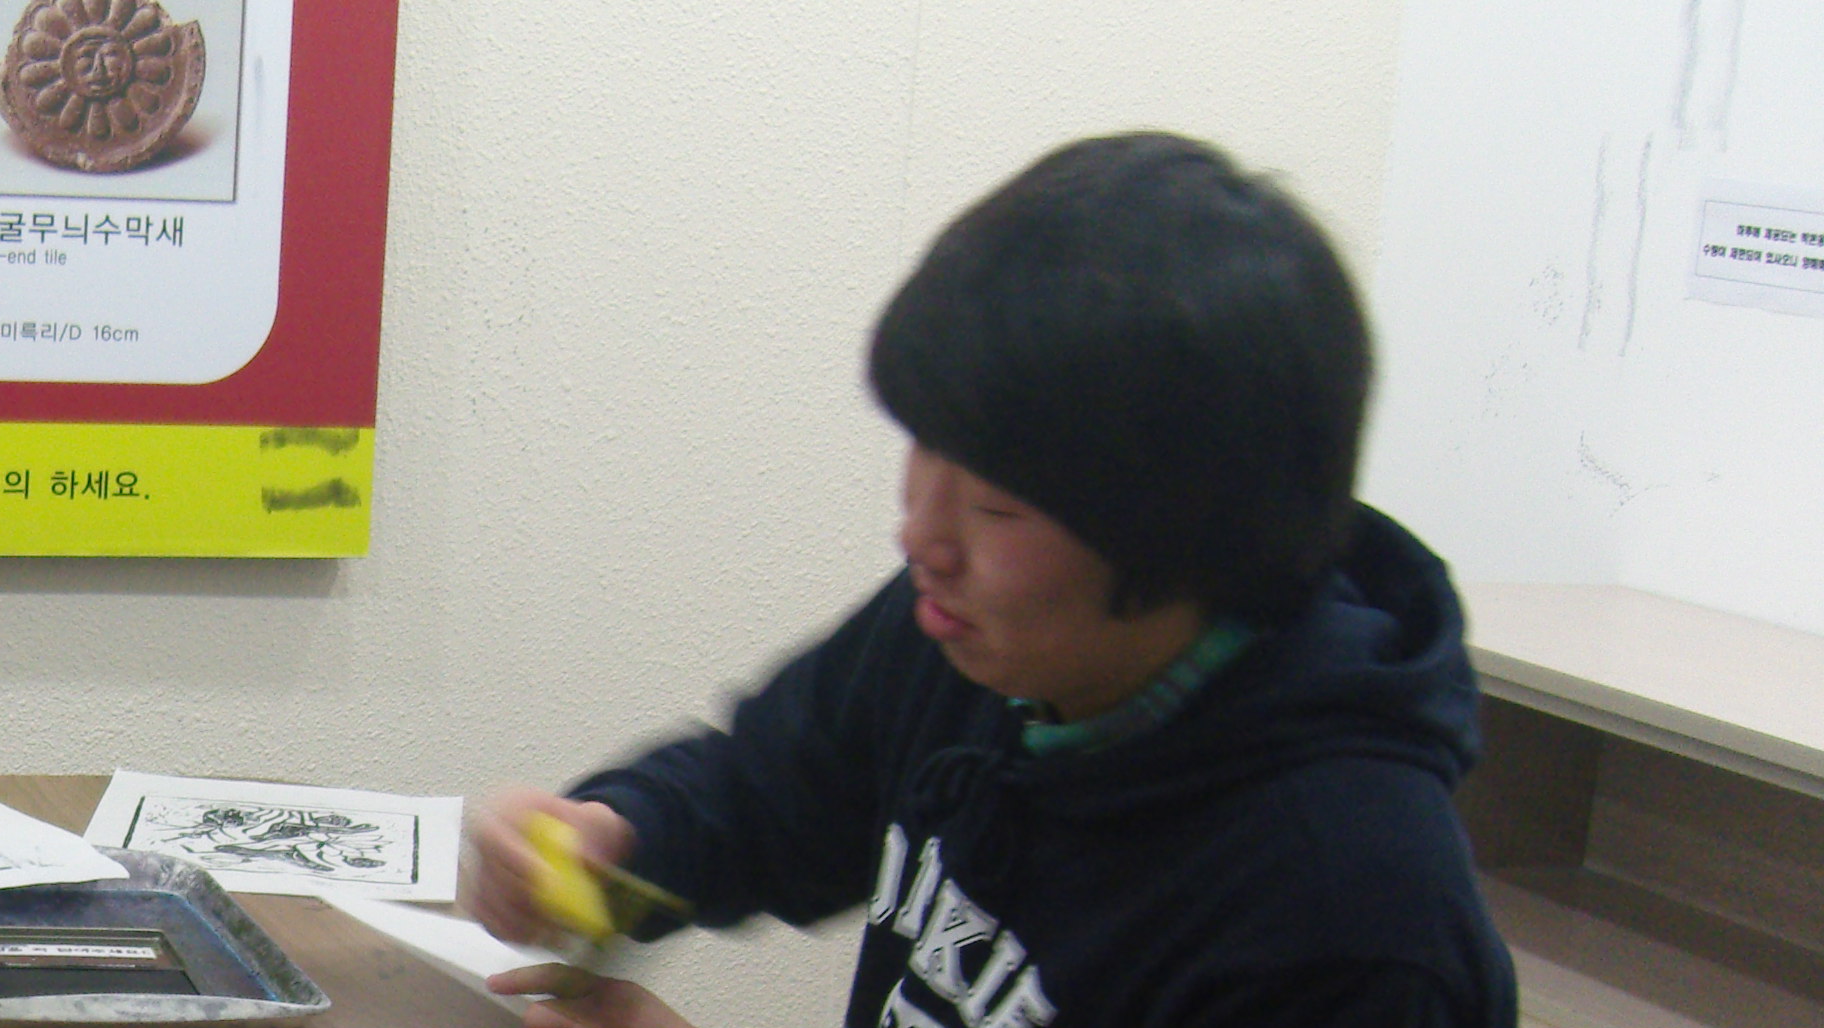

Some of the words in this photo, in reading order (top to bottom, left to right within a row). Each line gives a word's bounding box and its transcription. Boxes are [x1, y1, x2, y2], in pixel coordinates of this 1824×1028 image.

[45, 247, 67, 265] tile
[93, 325, 139, 342] 16cm
[50, 469, 150, 500] 하세요.
